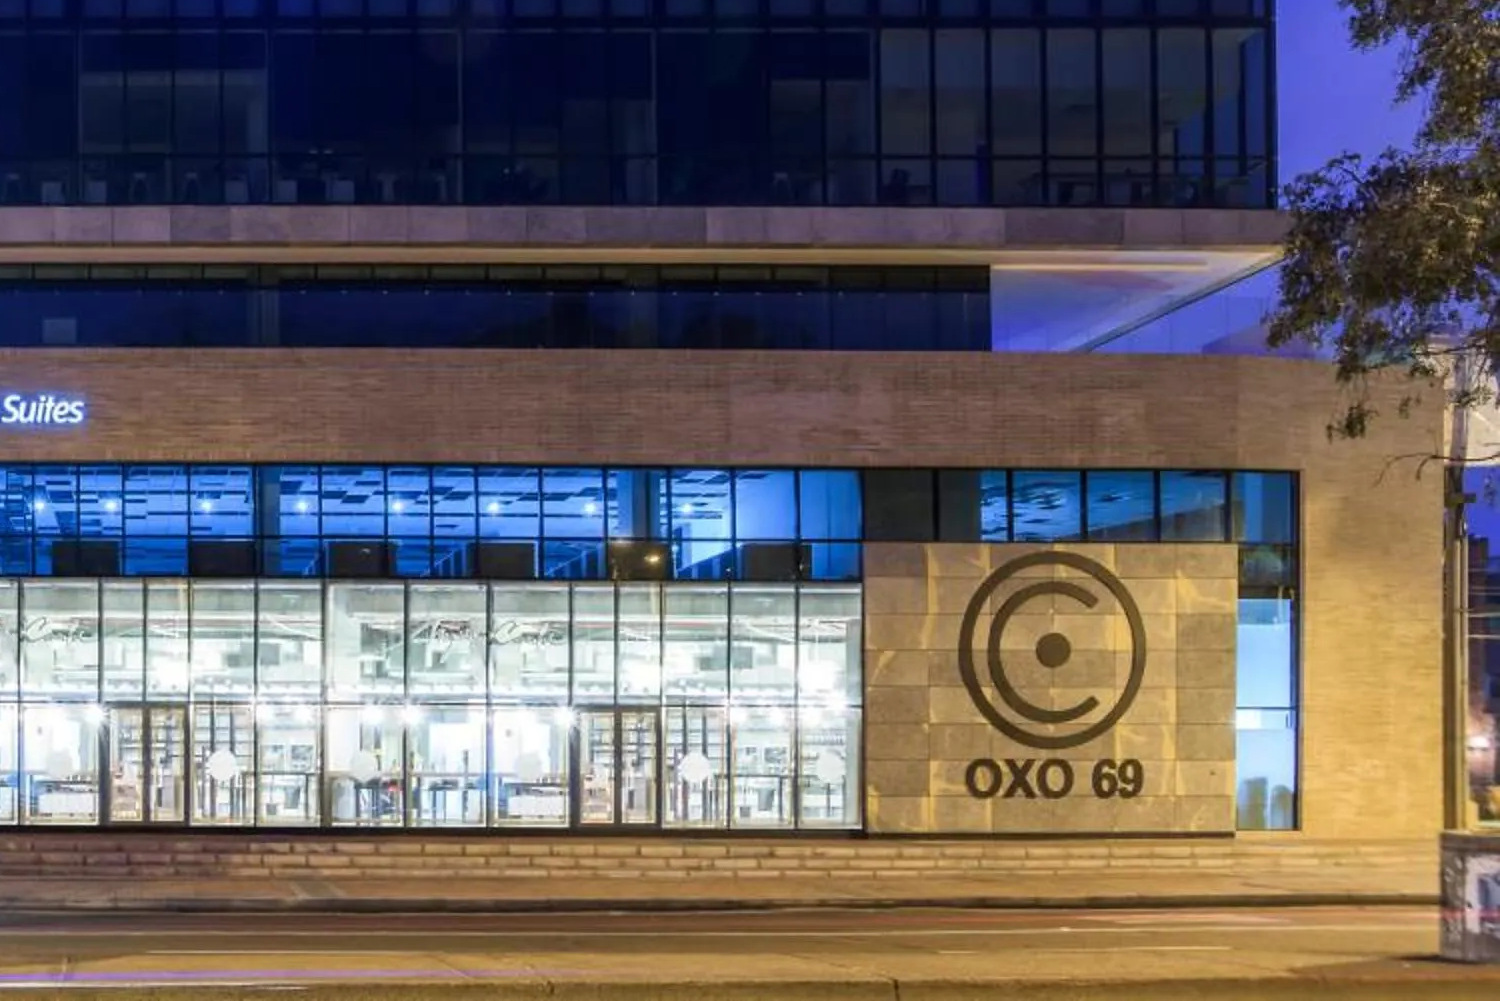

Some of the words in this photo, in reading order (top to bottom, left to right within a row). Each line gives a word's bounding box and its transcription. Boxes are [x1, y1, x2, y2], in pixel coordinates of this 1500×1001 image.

[1, 394, 85, 424] Suites
[965, 758, 1075, 799] OXO
[1092, 758, 1144, 799] 69
